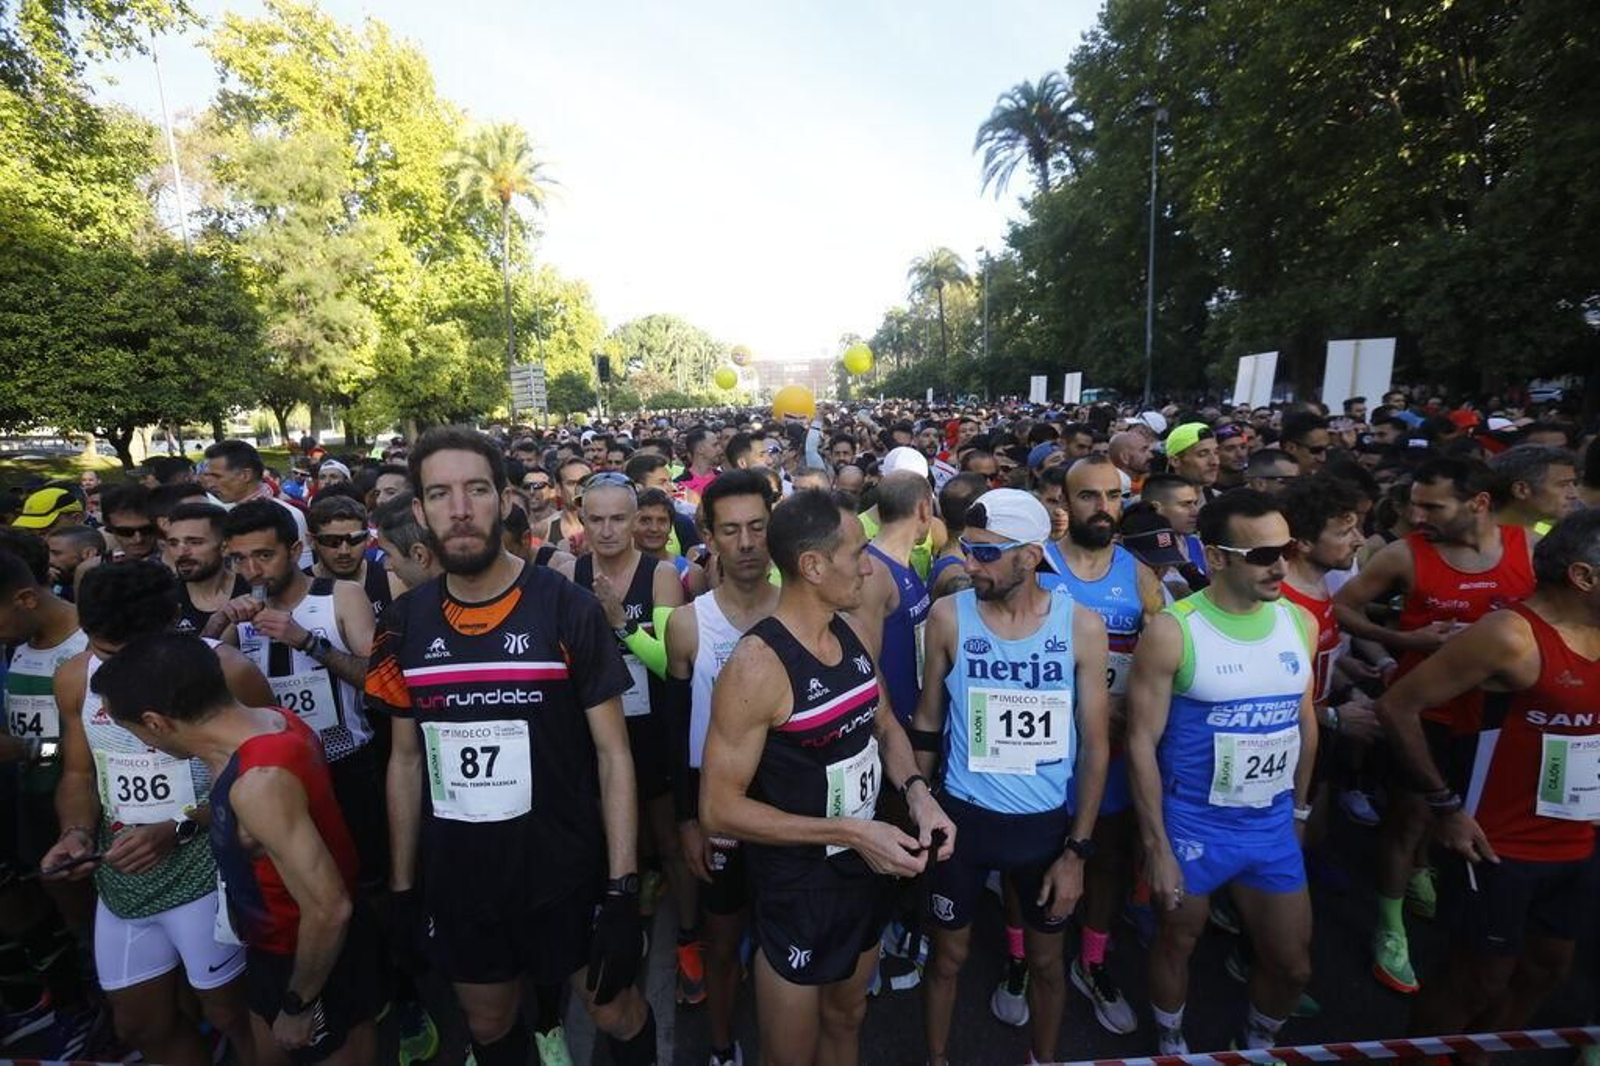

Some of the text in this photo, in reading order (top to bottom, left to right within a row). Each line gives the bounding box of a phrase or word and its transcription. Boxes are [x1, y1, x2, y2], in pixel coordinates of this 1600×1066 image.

[966, 653, 1064, 690] nerja
[999, 695, 1038, 704] IMDECO
[1212, 702, 1253, 713] CLUB
[973, 716, 982, 743] CAJÓN
[999, 709, 1051, 739] 131
[1525, 710, 1593, 727] SAN
[451, 728, 491, 739] IMDECO
[431, 754, 441, 785] CAJÓN
[460, 745, 501, 780] 87
[1245, 750, 1288, 780] 244
[117, 773, 171, 802] 386
[860, 763, 876, 803] 81
[833, 794, 841, 817] AJÓN
